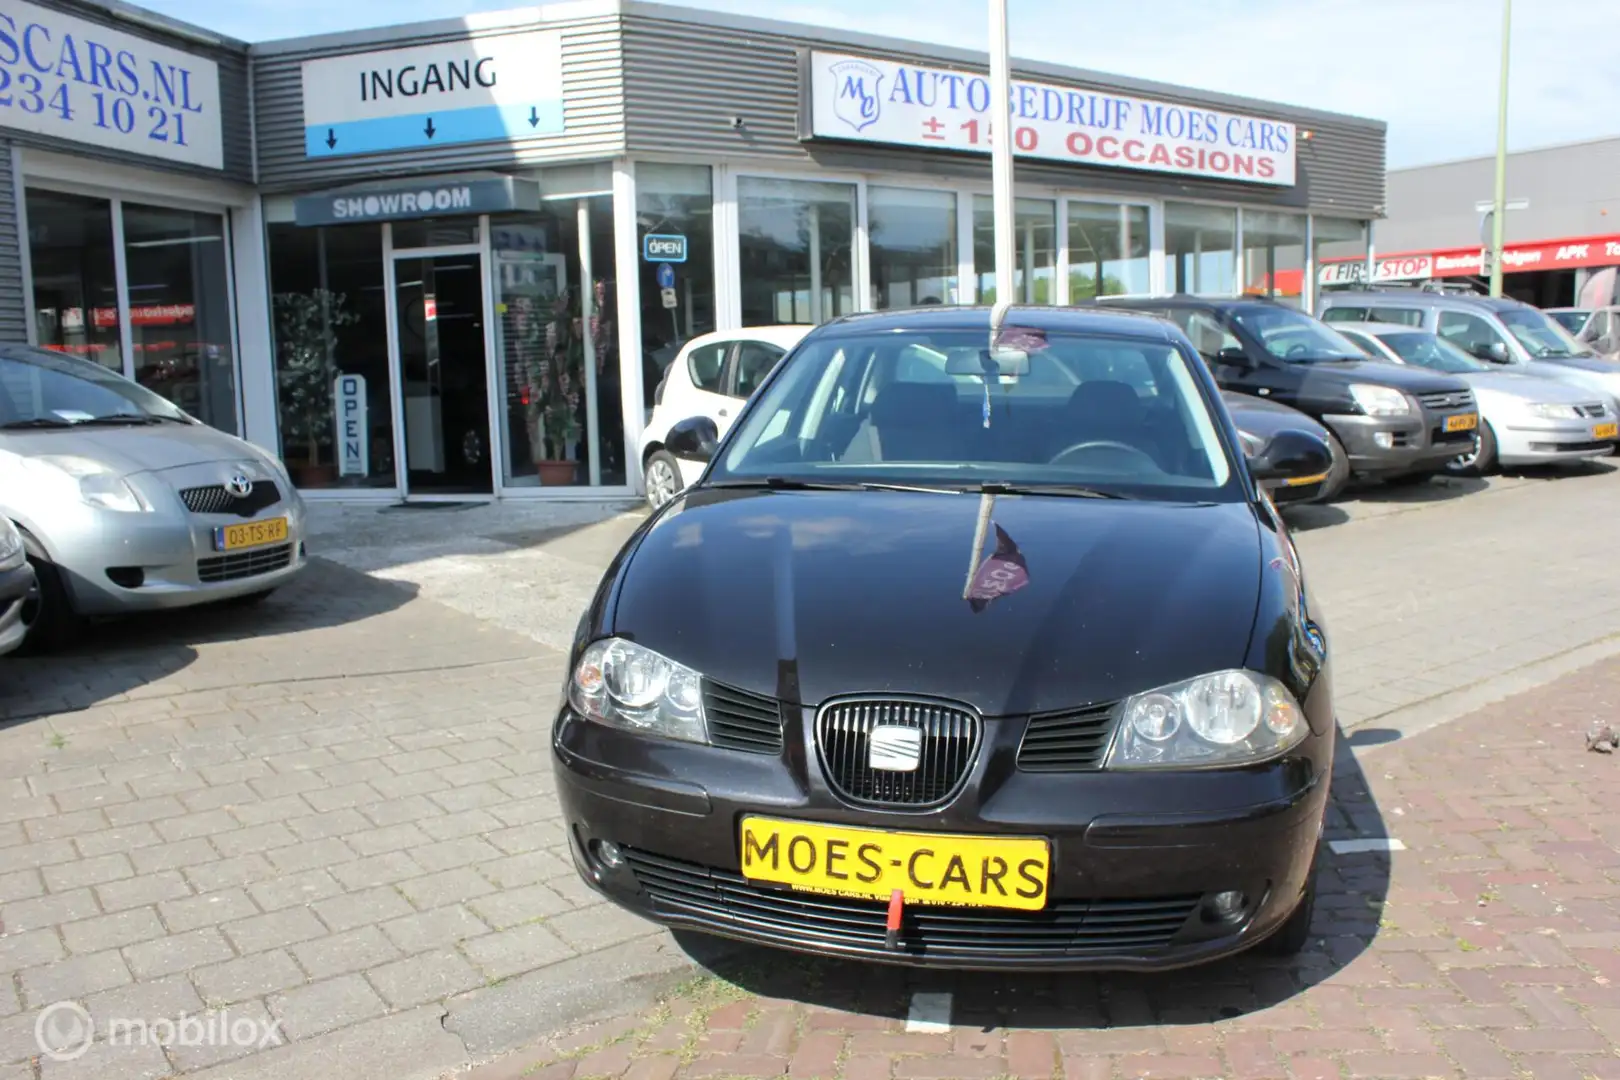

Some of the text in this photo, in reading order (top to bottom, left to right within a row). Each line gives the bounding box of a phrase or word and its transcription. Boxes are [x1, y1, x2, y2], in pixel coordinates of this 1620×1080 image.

[360, 57, 497, 101] INGANG
[92, 92, 135, 134] 10
[148, 106, 189, 147] 21
[889, 67, 1289, 154] AUTOEDRIJF MOES CARS
[960, 118, 1039, 151] 10
[1065, 132, 1276, 178] OCCASIONS
[333, 187, 471, 218] SHOWROOM
[649, 240, 682, 255] OPEN
[1555, 243, 1590, 260] APK
[342, 378, 360, 459] OPEN
[745, 829, 1045, 899] MOES-CARS
